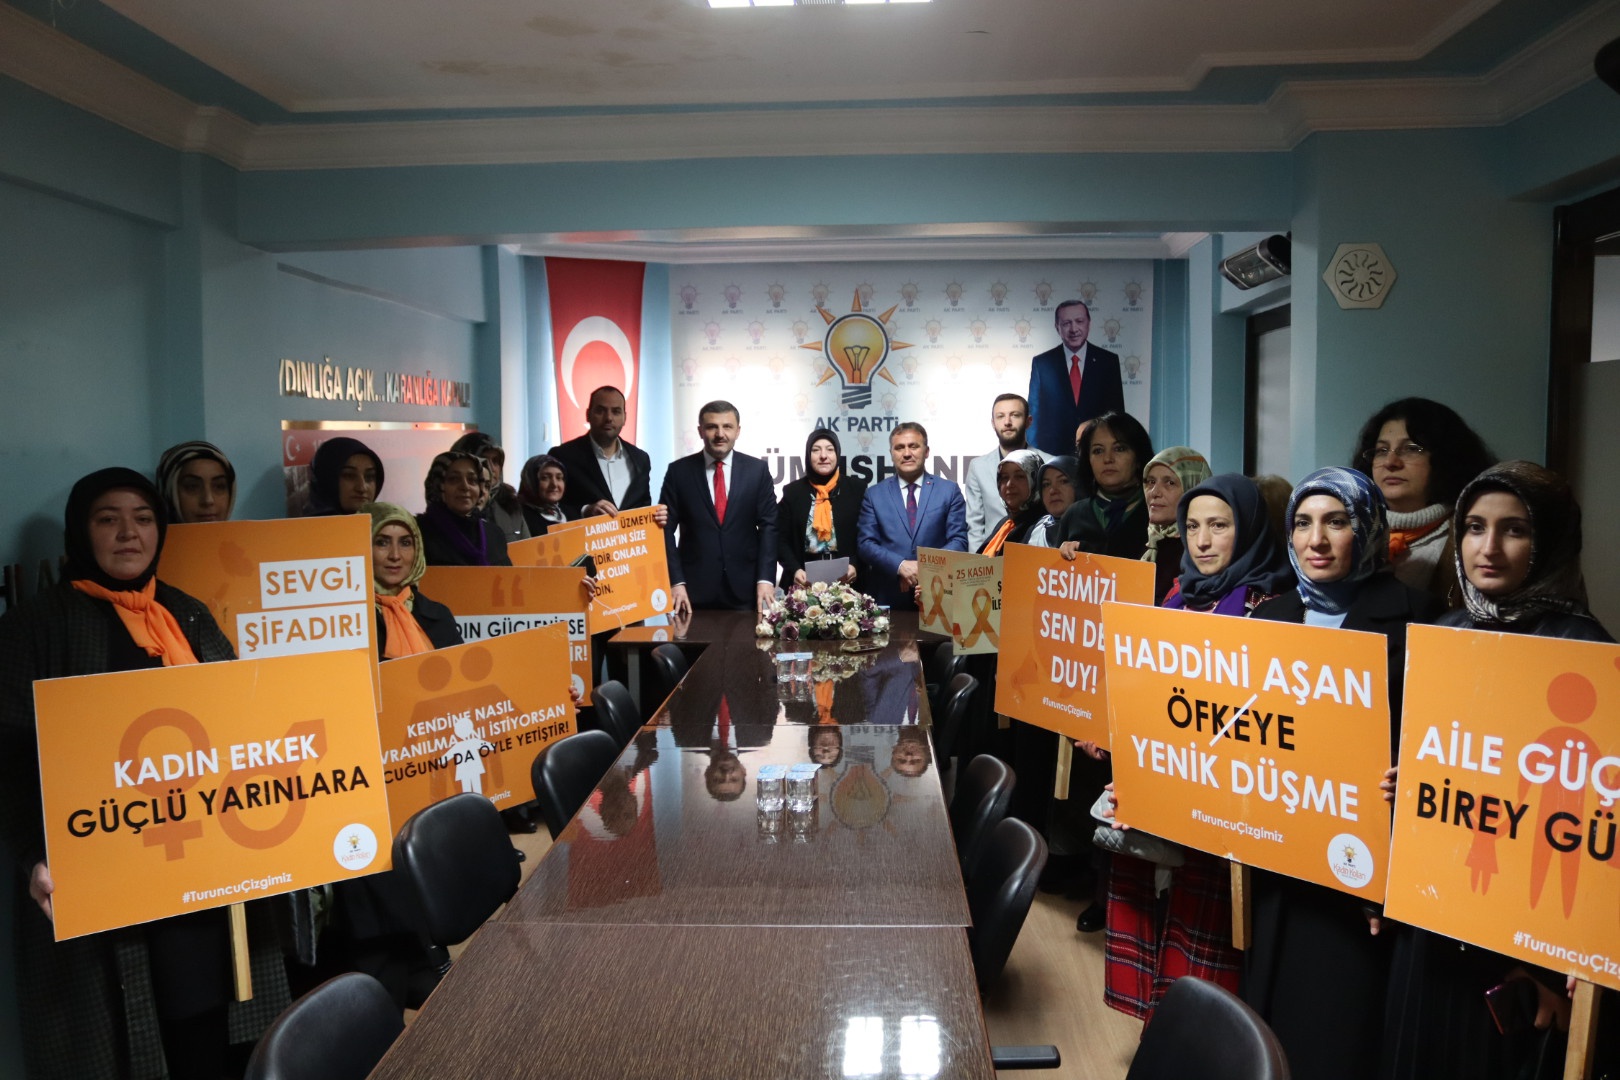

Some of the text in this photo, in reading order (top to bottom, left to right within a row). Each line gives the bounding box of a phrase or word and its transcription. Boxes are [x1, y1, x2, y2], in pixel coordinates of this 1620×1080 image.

[385, 370, 439, 406] KARANLIĞA
[814, 417, 840, 432] AK
[585, 520, 619, 537] LARINIZI
[591, 533, 628, 551] ALLAH'IN
[629, 529, 646, 543] SİZE
[607, 563, 630, 578] OLUN
[612, 544, 648, 561] ONLARA
[928, 555, 946, 566] KASIM
[265, 560, 361, 596] SEVGİ,
[956, 569, 966, 580] 25
[967, 565, 994, 578] KASIM
[1036, 565, 1117, 605] SESİMİZİ
[245, 612, 362, 653] ŞİFADIR!
[1040, 610, 1076, 644] SEN
[1051, 655, 1098, 695] DUY!
[1114, 633, 1372, 709] HADDİNİ AŞAN
[475, 699, 515, 722] NASIL
[489, 703, 566, 737] İSTİYORSAN
[1042, 696, 1092, 720] #TuruncuÇizgimiz
[1167, 686, 1296, 751] ÖFKEYE
[113, 733, 320, 789] KADIN ERKEK
[384, 721, 570, 785] CUĞUNU DA ÖYLE YETİŞTİR!
[1416, 720, 1620, 807] AİLE GÜÇ
[1131, 734, 1358, 822] YENİK DÜŞME
[66, 765, 370, 838] GÜÇLÜ YARINLARA
[1416, 777, 1617, 862] BİREY GÜ
[1191, 808, 1284, 844] #TuruncuÇizgimiz
[182, 871, 293, 904] #TuruncuÇizgimiz
